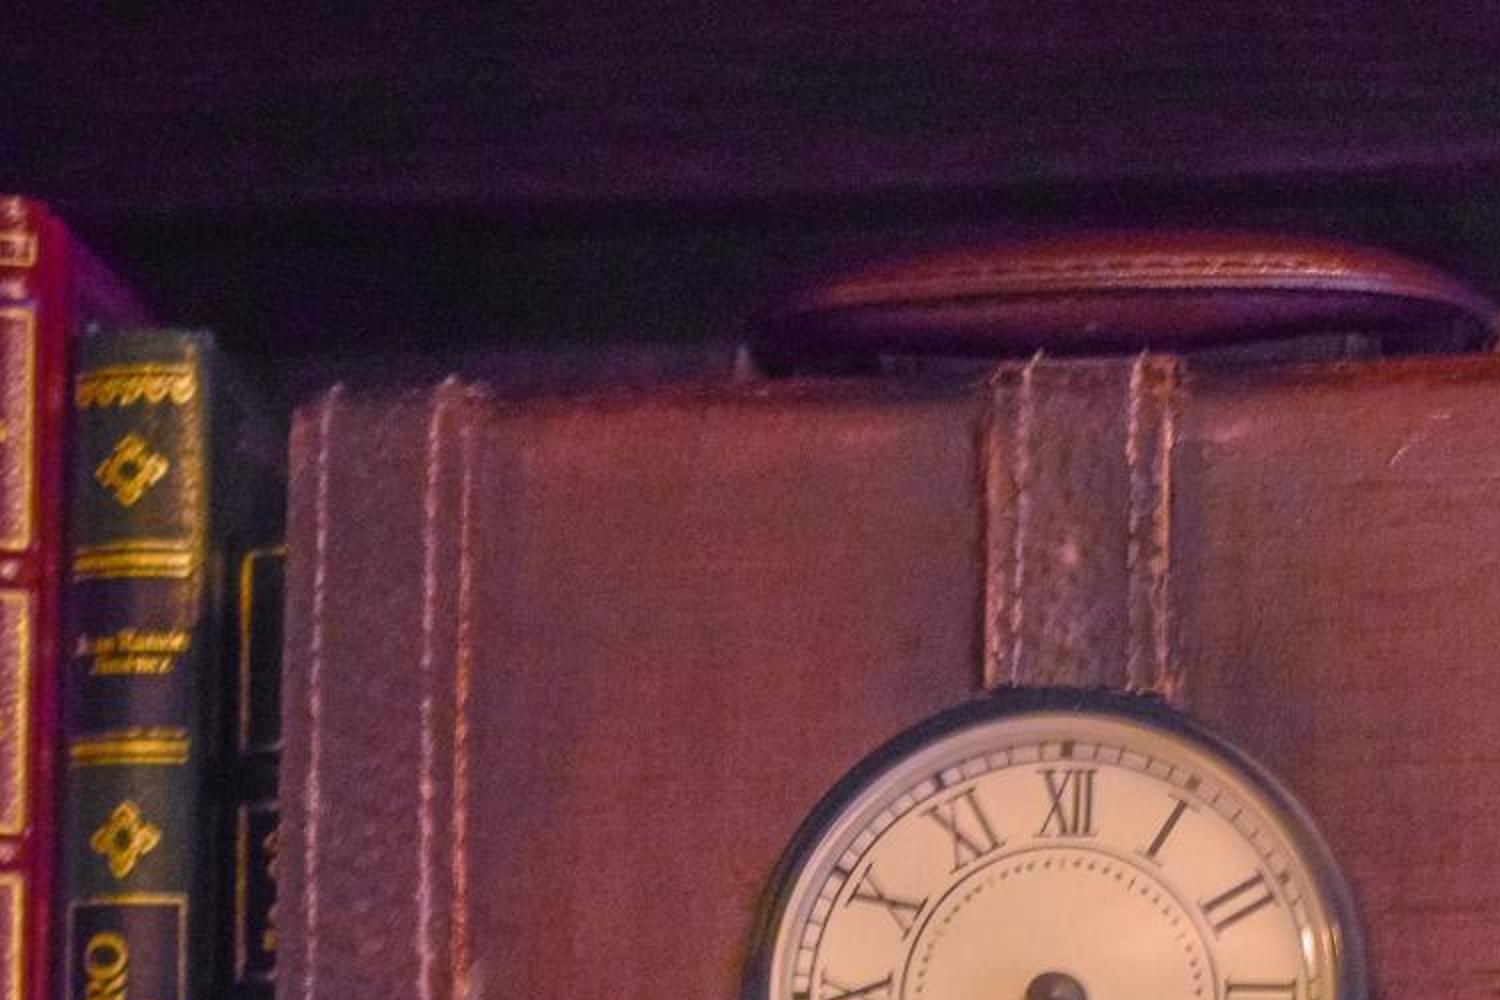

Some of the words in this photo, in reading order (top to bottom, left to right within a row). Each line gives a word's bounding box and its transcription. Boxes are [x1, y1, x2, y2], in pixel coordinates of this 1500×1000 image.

[925, 788, 1006, 874] XI
[1033, 769, 1098, 837] XII
[846, 863, 927, 939] X
[1199, 872, 1275, 939] II
